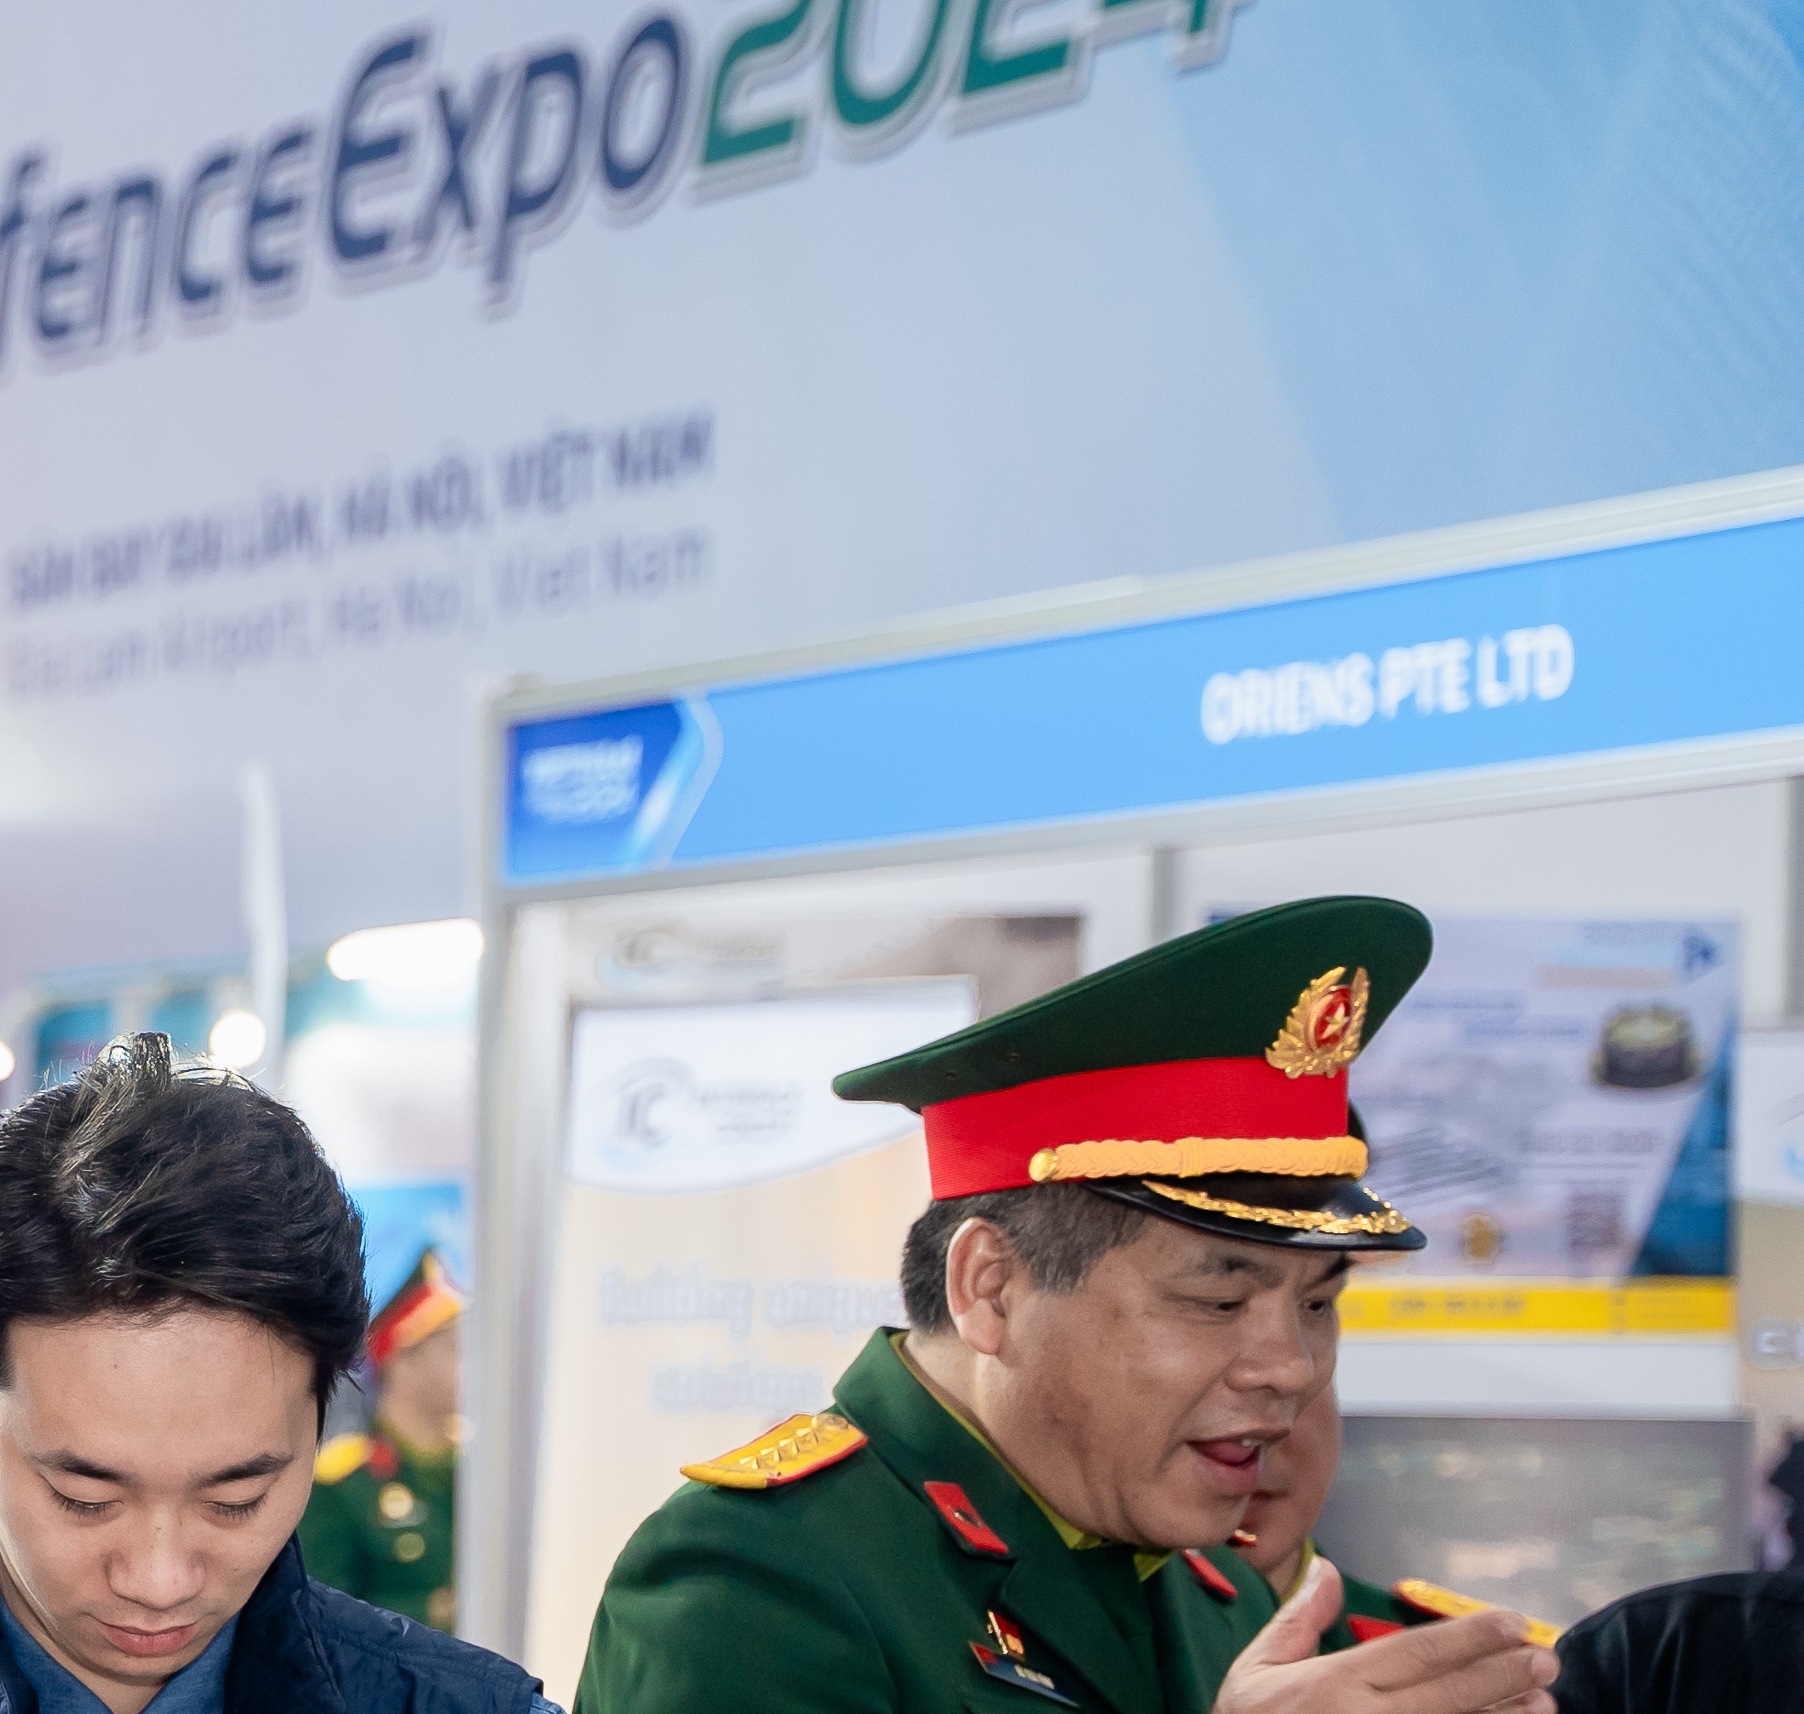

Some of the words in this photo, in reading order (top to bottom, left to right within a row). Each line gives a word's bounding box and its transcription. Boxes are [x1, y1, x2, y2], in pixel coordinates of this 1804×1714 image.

[1201, 652, 1375, 745] ORIENS
[1380, 638, 1471, 719] PTE
[1476, 624, 1575, 708] LTD
